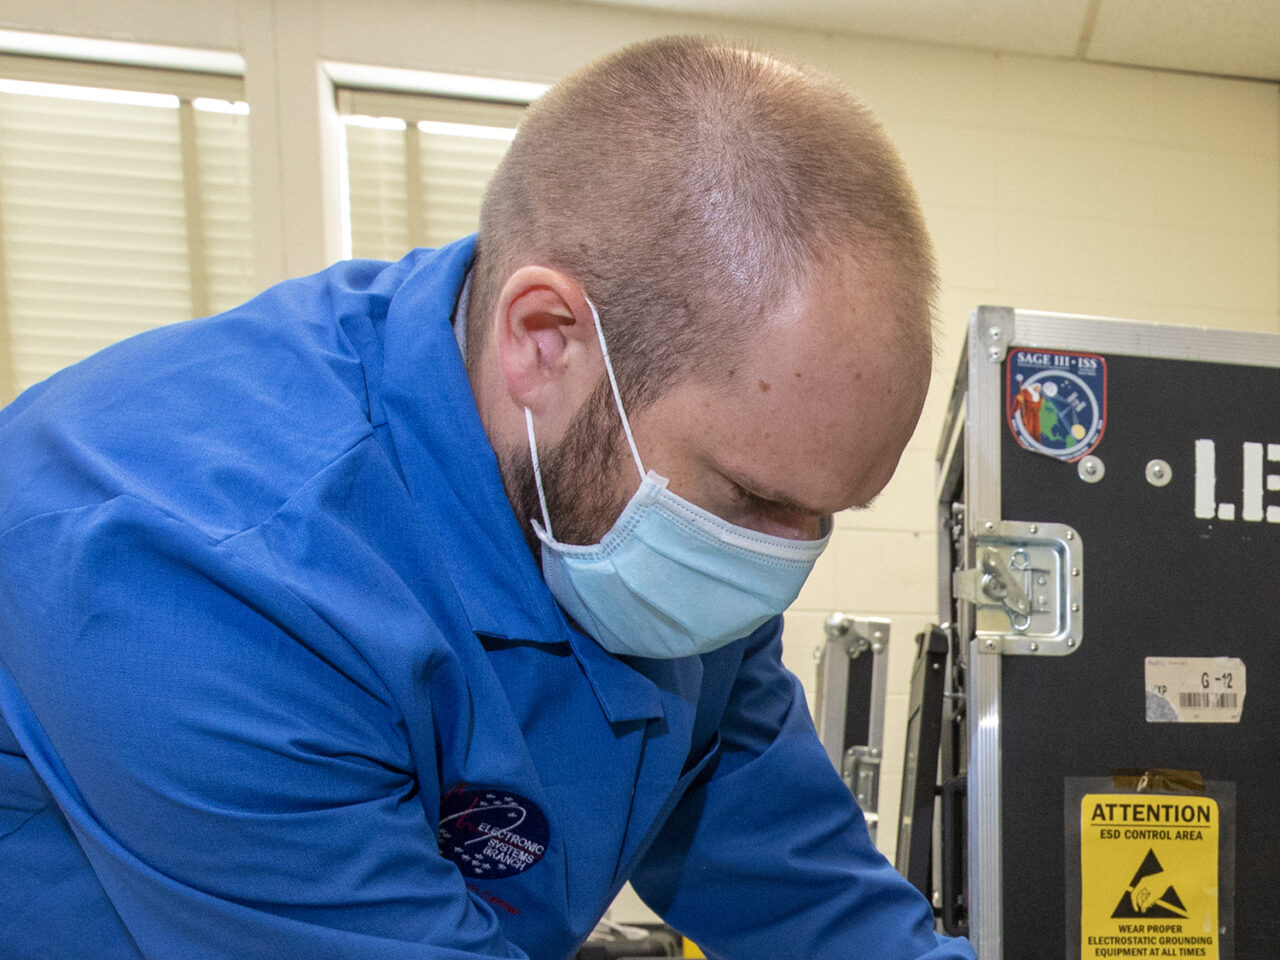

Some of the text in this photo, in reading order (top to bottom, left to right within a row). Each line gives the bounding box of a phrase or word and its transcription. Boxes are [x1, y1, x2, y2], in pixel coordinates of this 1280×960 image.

[1017, 352, 1051, 365] SAGE
[1053, 355, 1070, 366] III
[1077, 357, 1098, 369] ISS
[1201, 672, 1210, 689] G
[1091, 803, 1211, 823] ATTENTION
[478, 822, 545, 856] ELECTRONIC
[1100, 829, 1203, 841] ESD CONTROL AREA
[483, 846, 527, 871] BRANCH
[487, 838, 535, 864] SYSTEMS
[1118, 924, 1183, 934] WEAR PROPER
[1088, 936, 1213, 946] ELECTROSTATIC GROUNDING
[1095, 948, 1206, 957] EQUIPMENT AT ALL TIMES
